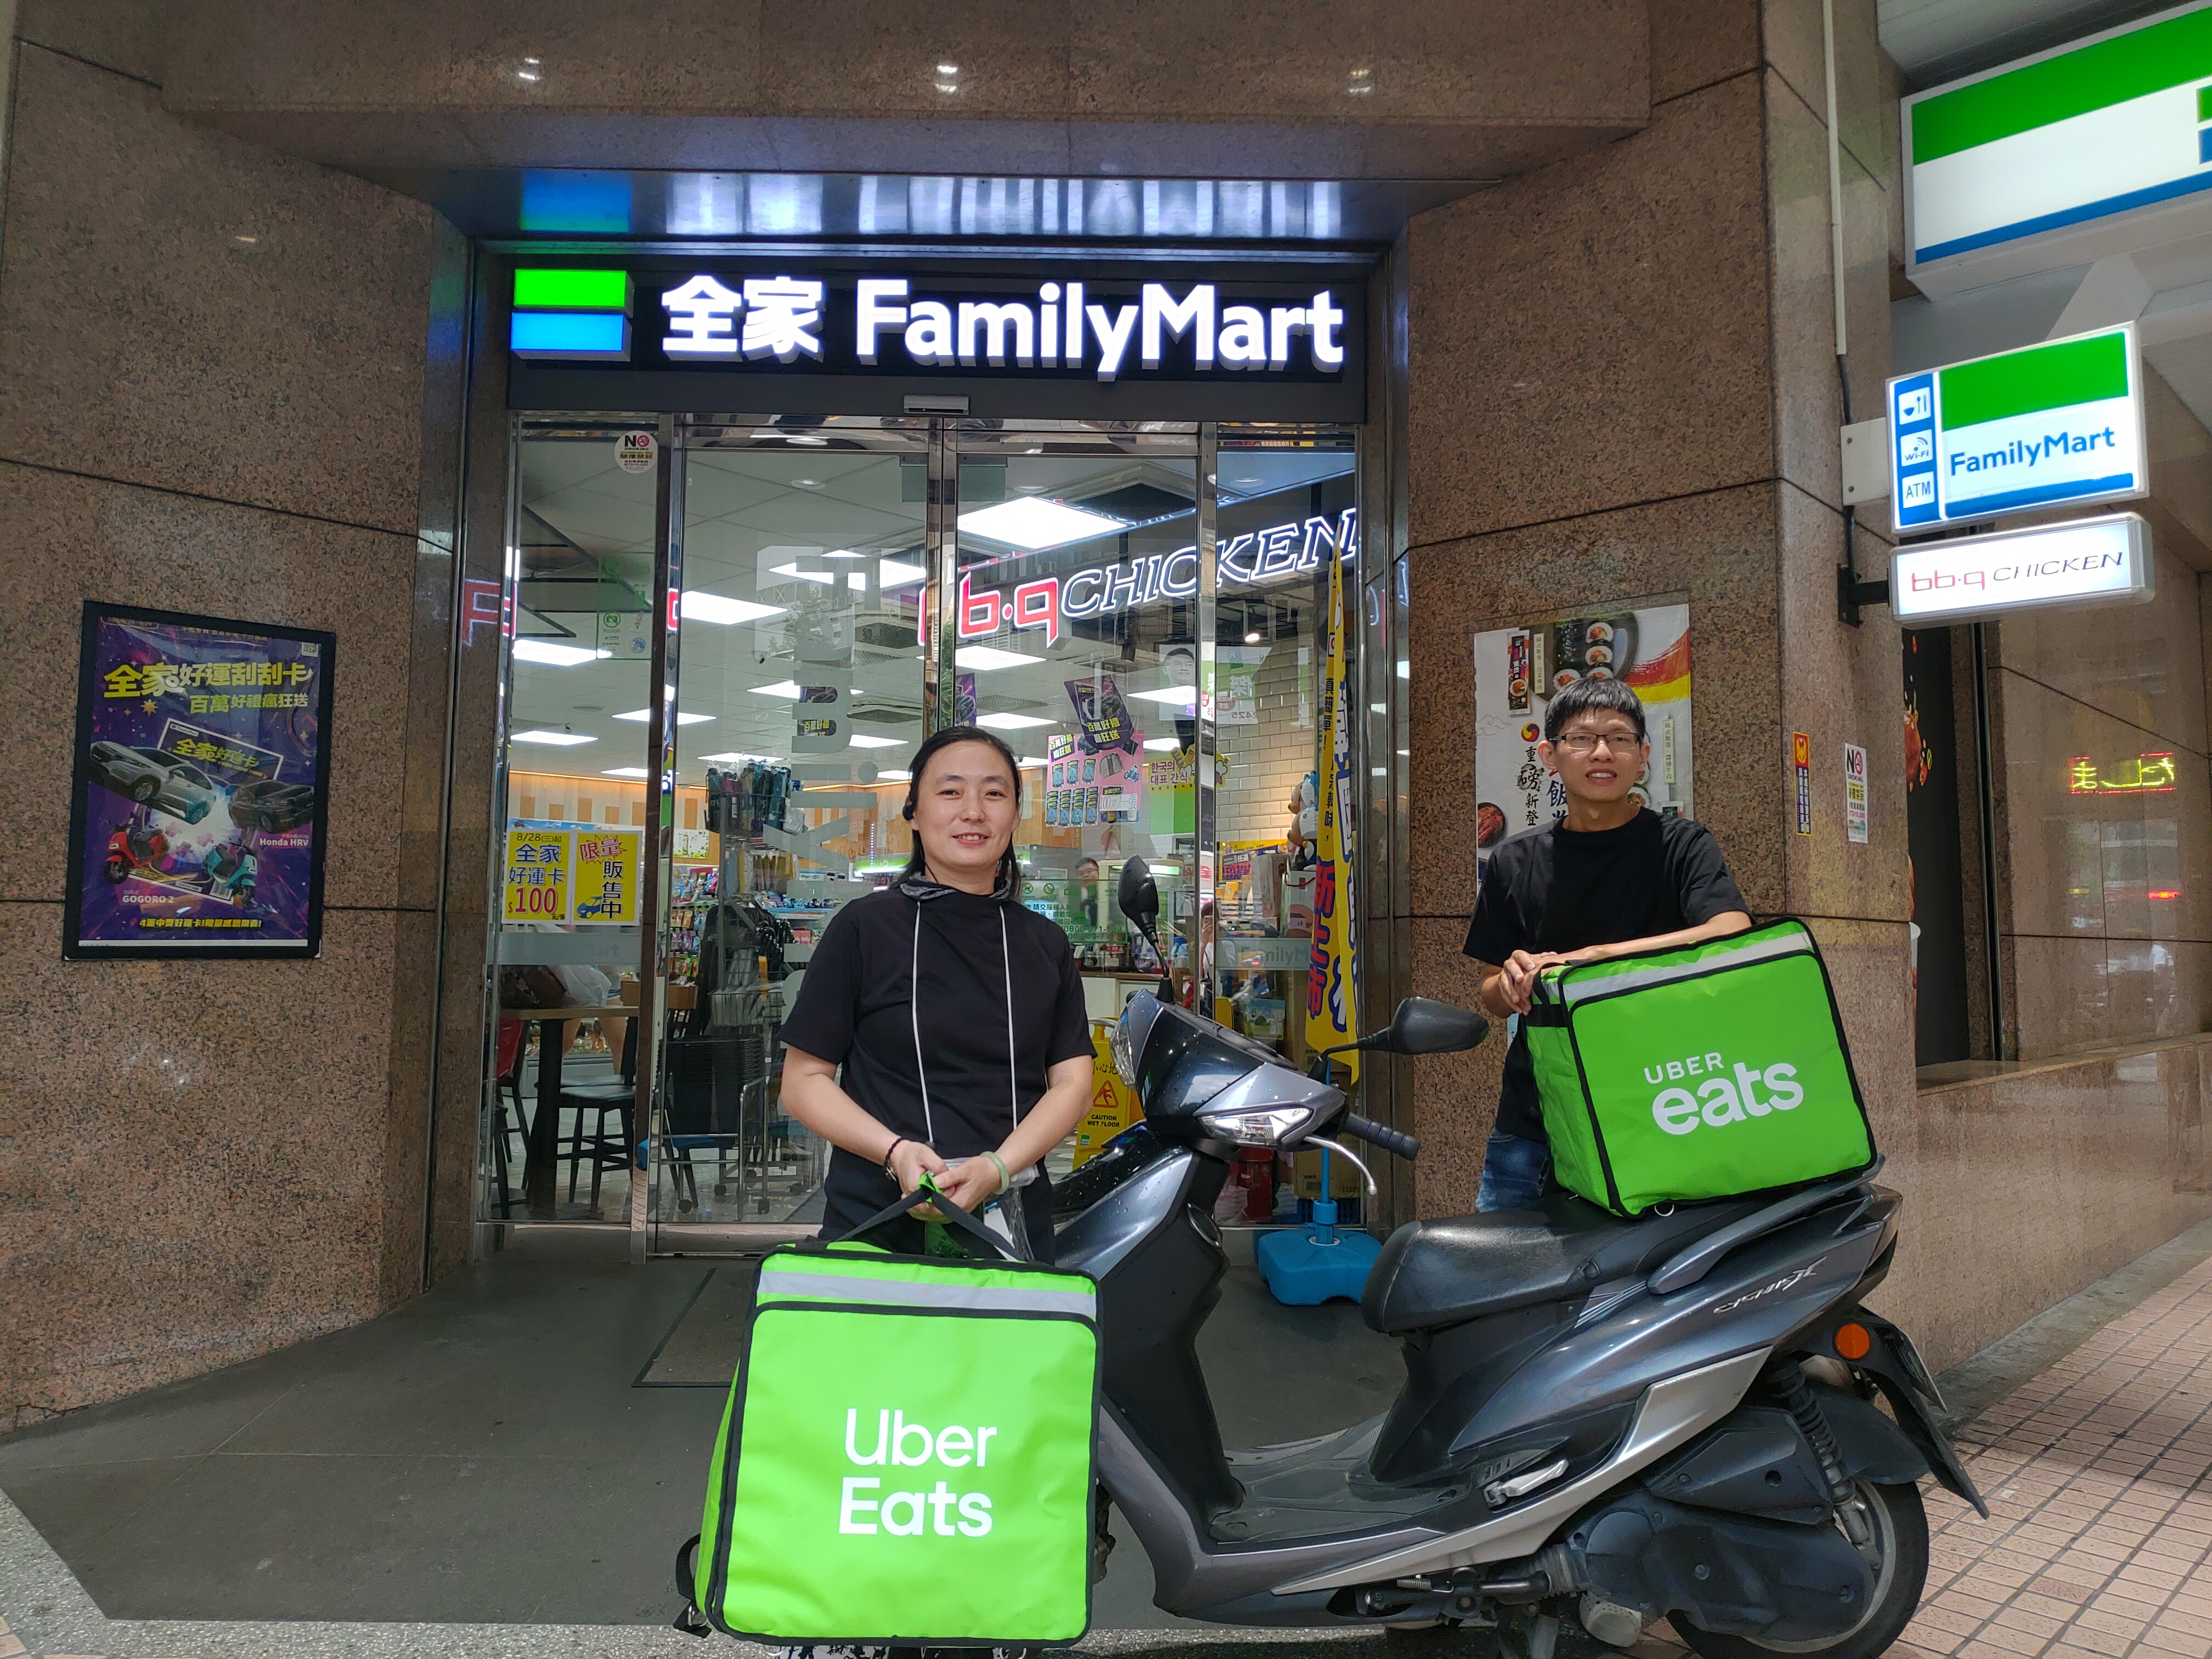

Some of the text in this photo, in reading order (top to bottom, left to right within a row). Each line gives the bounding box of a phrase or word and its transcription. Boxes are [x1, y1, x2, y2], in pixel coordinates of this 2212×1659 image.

[661, 274, 1344, 380] 全家 FamilyMart
[1905, 450, 1929, 461] Wi-Fi
[1950, 426, 2115, 476] FamilyMart
[1906, 481, 1931, 499] ATM
[1062, 507, 1356, 617] CHICKEN
[1993, 552, 2123, 582] CHICKEN
[103, 662, 314, 698] 全家好運刮刮卡
[190, 692, 308, 714] 百萬好禮瘋狂送
[1150, 760, 1175, 774] 한국의
[1150, 771, 1188, 786] 대표 간식
[259, 838, 288, 846] Honda
[515, 843, 561, 864] 全家
[580, 838, 621, 861] 限量
[508, 866, 565, 885] 好運卡
[122, 895, 166, 904] GOGORO
[601, 861, 624, 919] 販售中
[1644, 1052, 1724, 1084] UBER
[1652, 1062, 1804, 1135] eats
[845, 1408, 997, 1467] Uber
[838, 1477, 992, 1537] Eats
